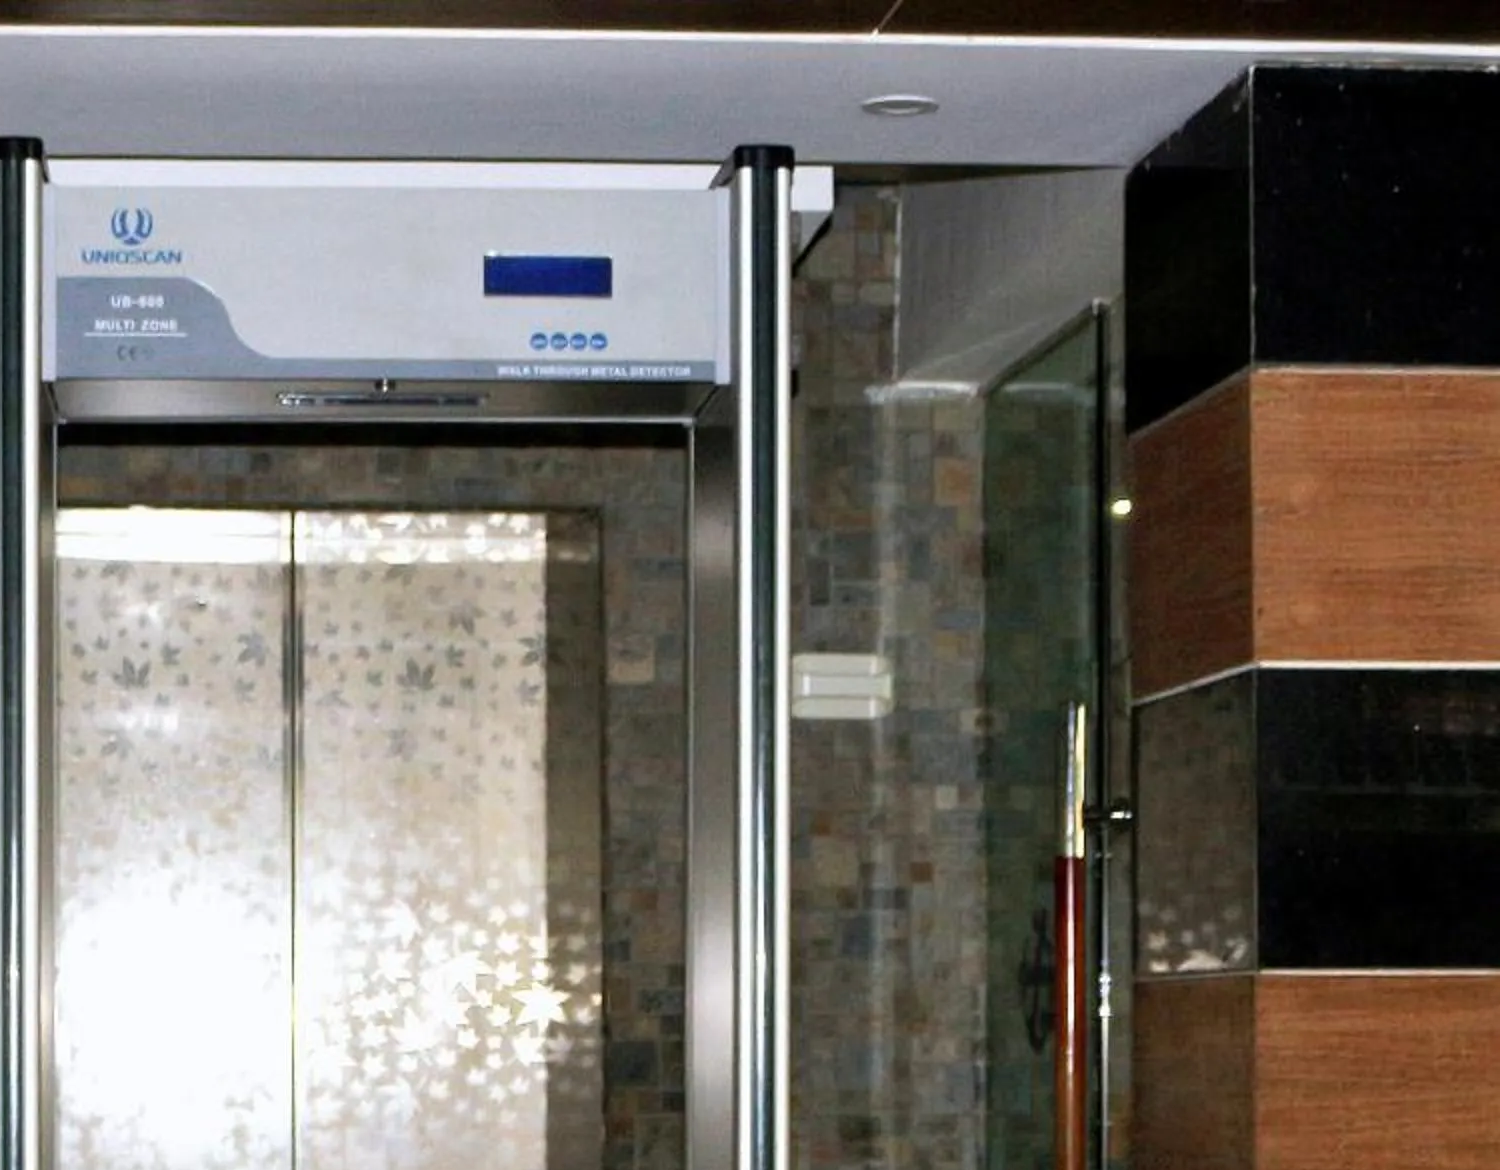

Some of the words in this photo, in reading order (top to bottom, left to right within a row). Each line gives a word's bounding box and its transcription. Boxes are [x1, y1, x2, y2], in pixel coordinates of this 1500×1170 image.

[94, 319, 135, 331] MULTI
[141, 319, 178, 331] ZONE
[498, 366, 530, 377] WALK
[533, 366, 589, 377] THROUGH
[592, 366, 628, 377] METAL
[631, 366, 691, 377] DETECTOR
